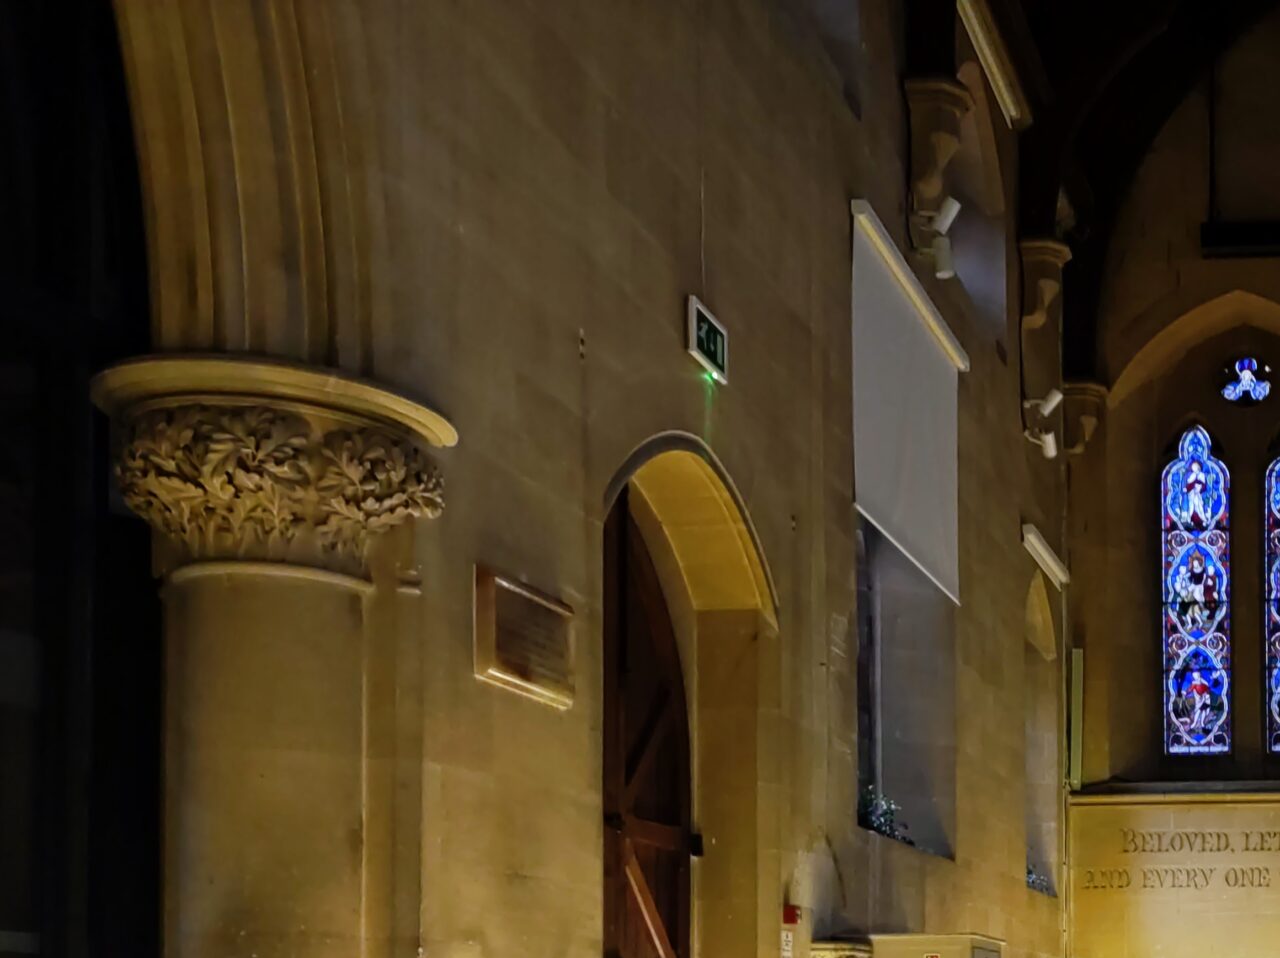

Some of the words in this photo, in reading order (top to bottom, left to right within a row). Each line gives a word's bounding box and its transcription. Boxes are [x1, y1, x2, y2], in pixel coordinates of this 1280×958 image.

[1119, 828, 1235, 854] BELOVED,
[1081, 868, 1132, 891] AND
[1141, 867, 1217, 890] EVERY
[1225, 866, 1271, 889] ONE
